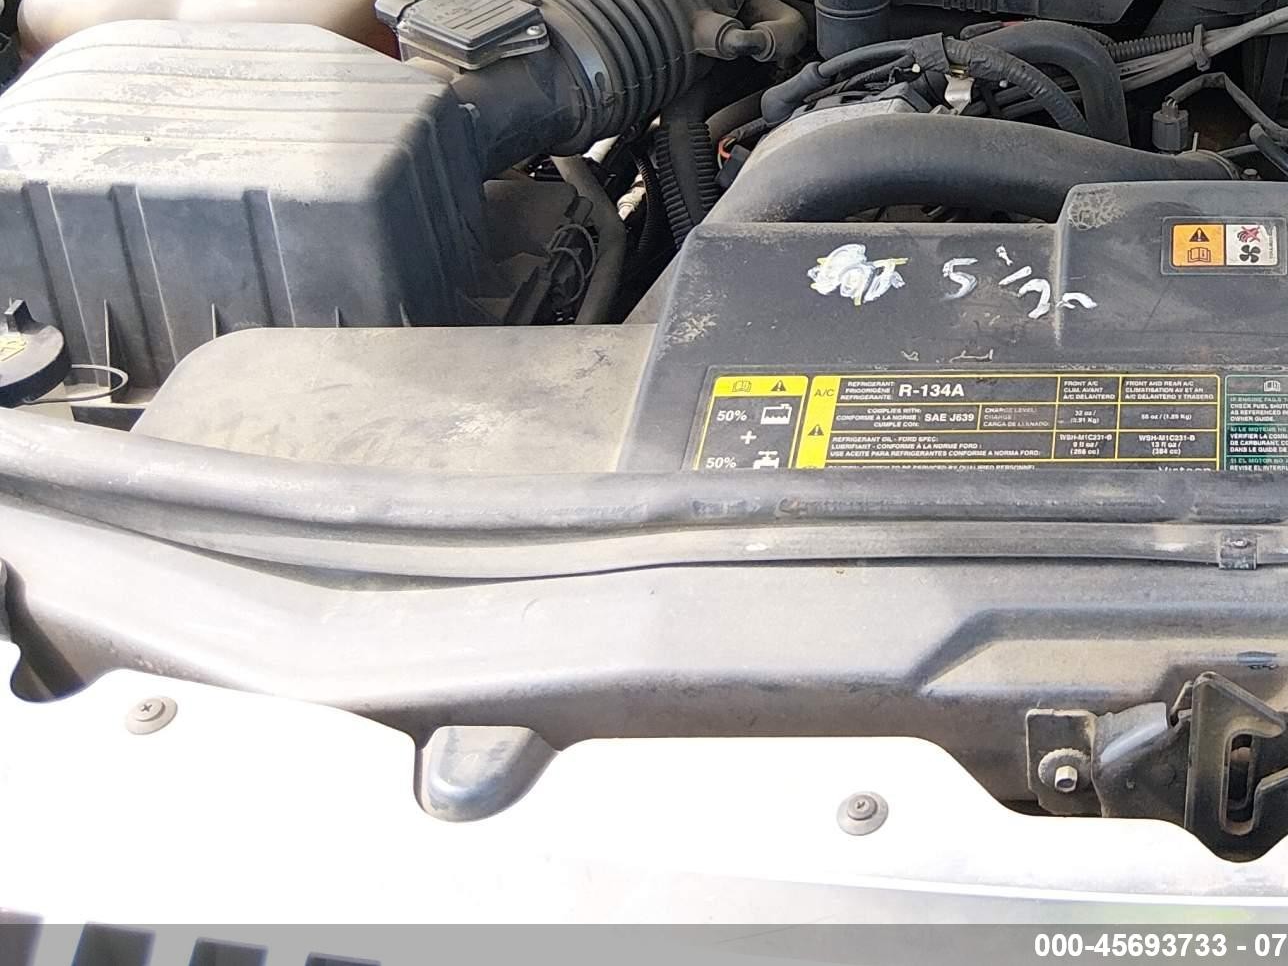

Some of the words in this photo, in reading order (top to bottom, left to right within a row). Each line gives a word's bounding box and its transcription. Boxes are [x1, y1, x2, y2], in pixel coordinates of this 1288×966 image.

[814, 389, 835, 397] A/C
[898, 383, 965, 397] R-134A
[716, 410, 748, 422] 50%
[924, 413, 947, 422] SAE
[705, 457, 737, 469] 50%
